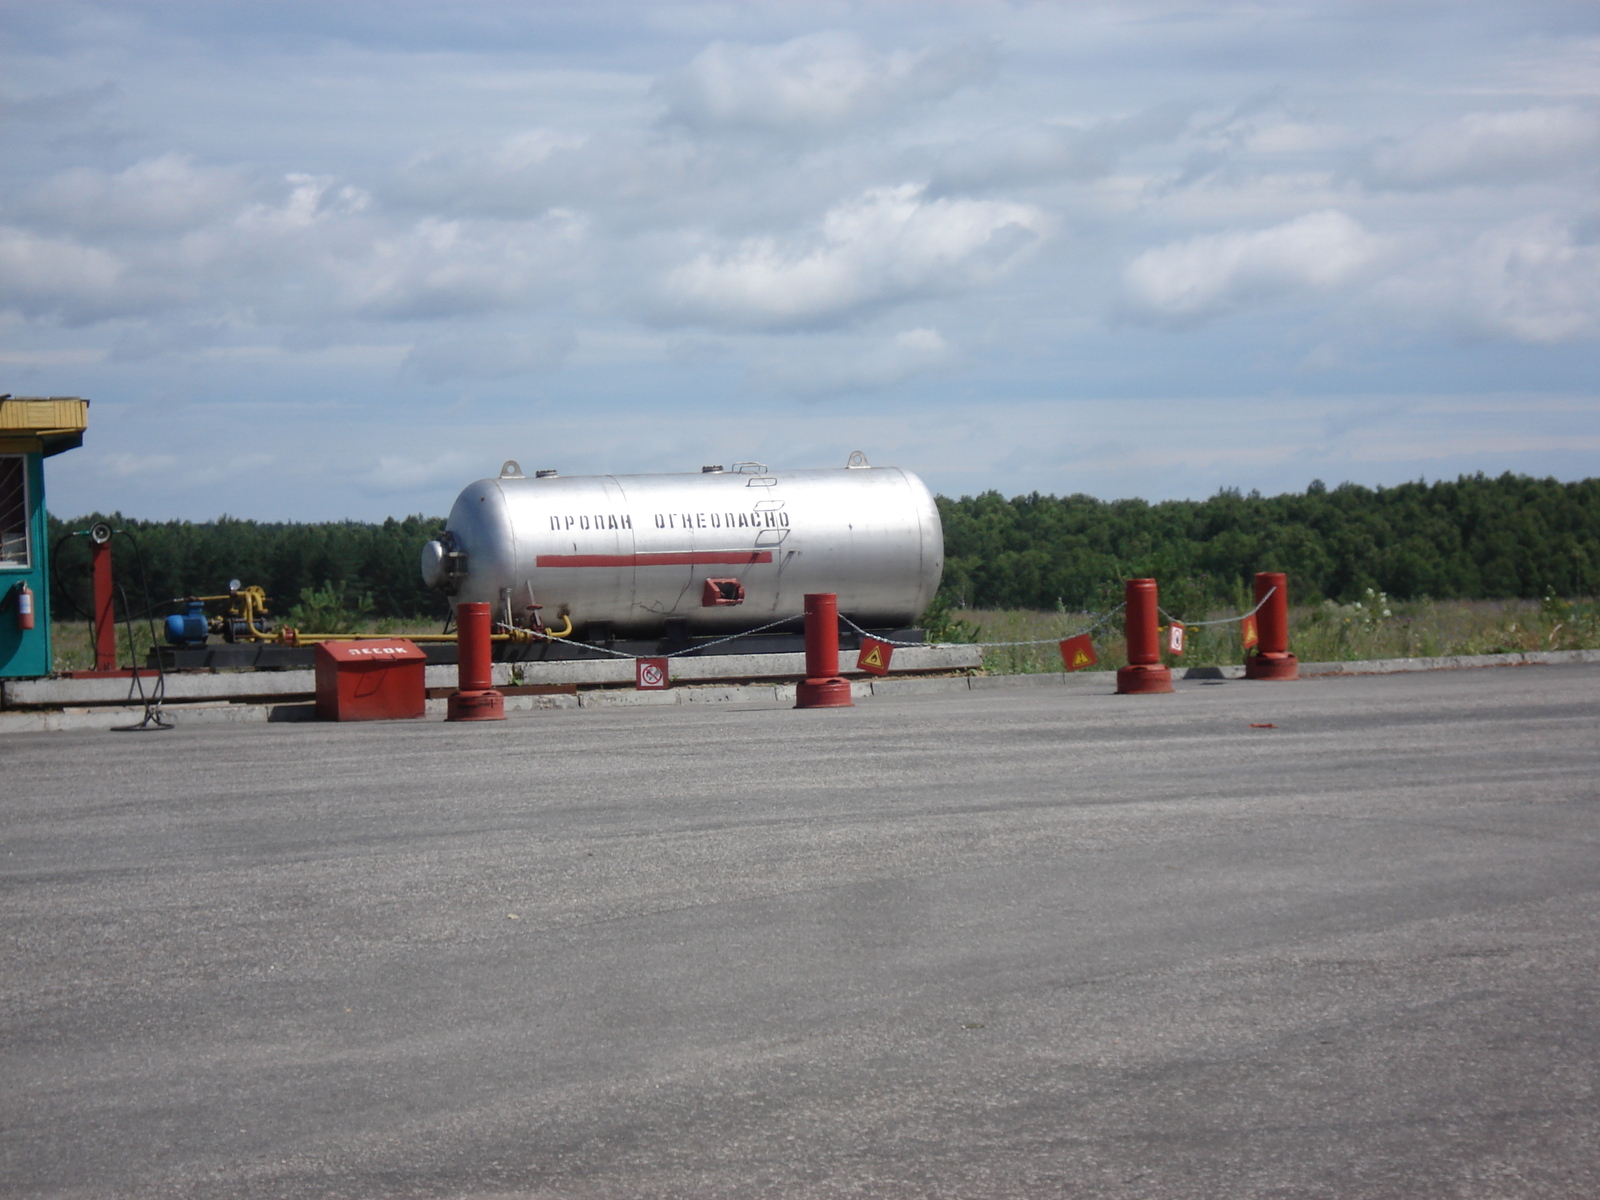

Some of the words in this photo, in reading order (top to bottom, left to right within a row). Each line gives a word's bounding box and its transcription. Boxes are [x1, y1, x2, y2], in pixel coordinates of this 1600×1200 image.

[550, 514, 632, 531] ПРОПАН
[654, 511, 790, 529] ОГНЕОПАСНО
[348, 646, 408, 656] ПЕСОК
